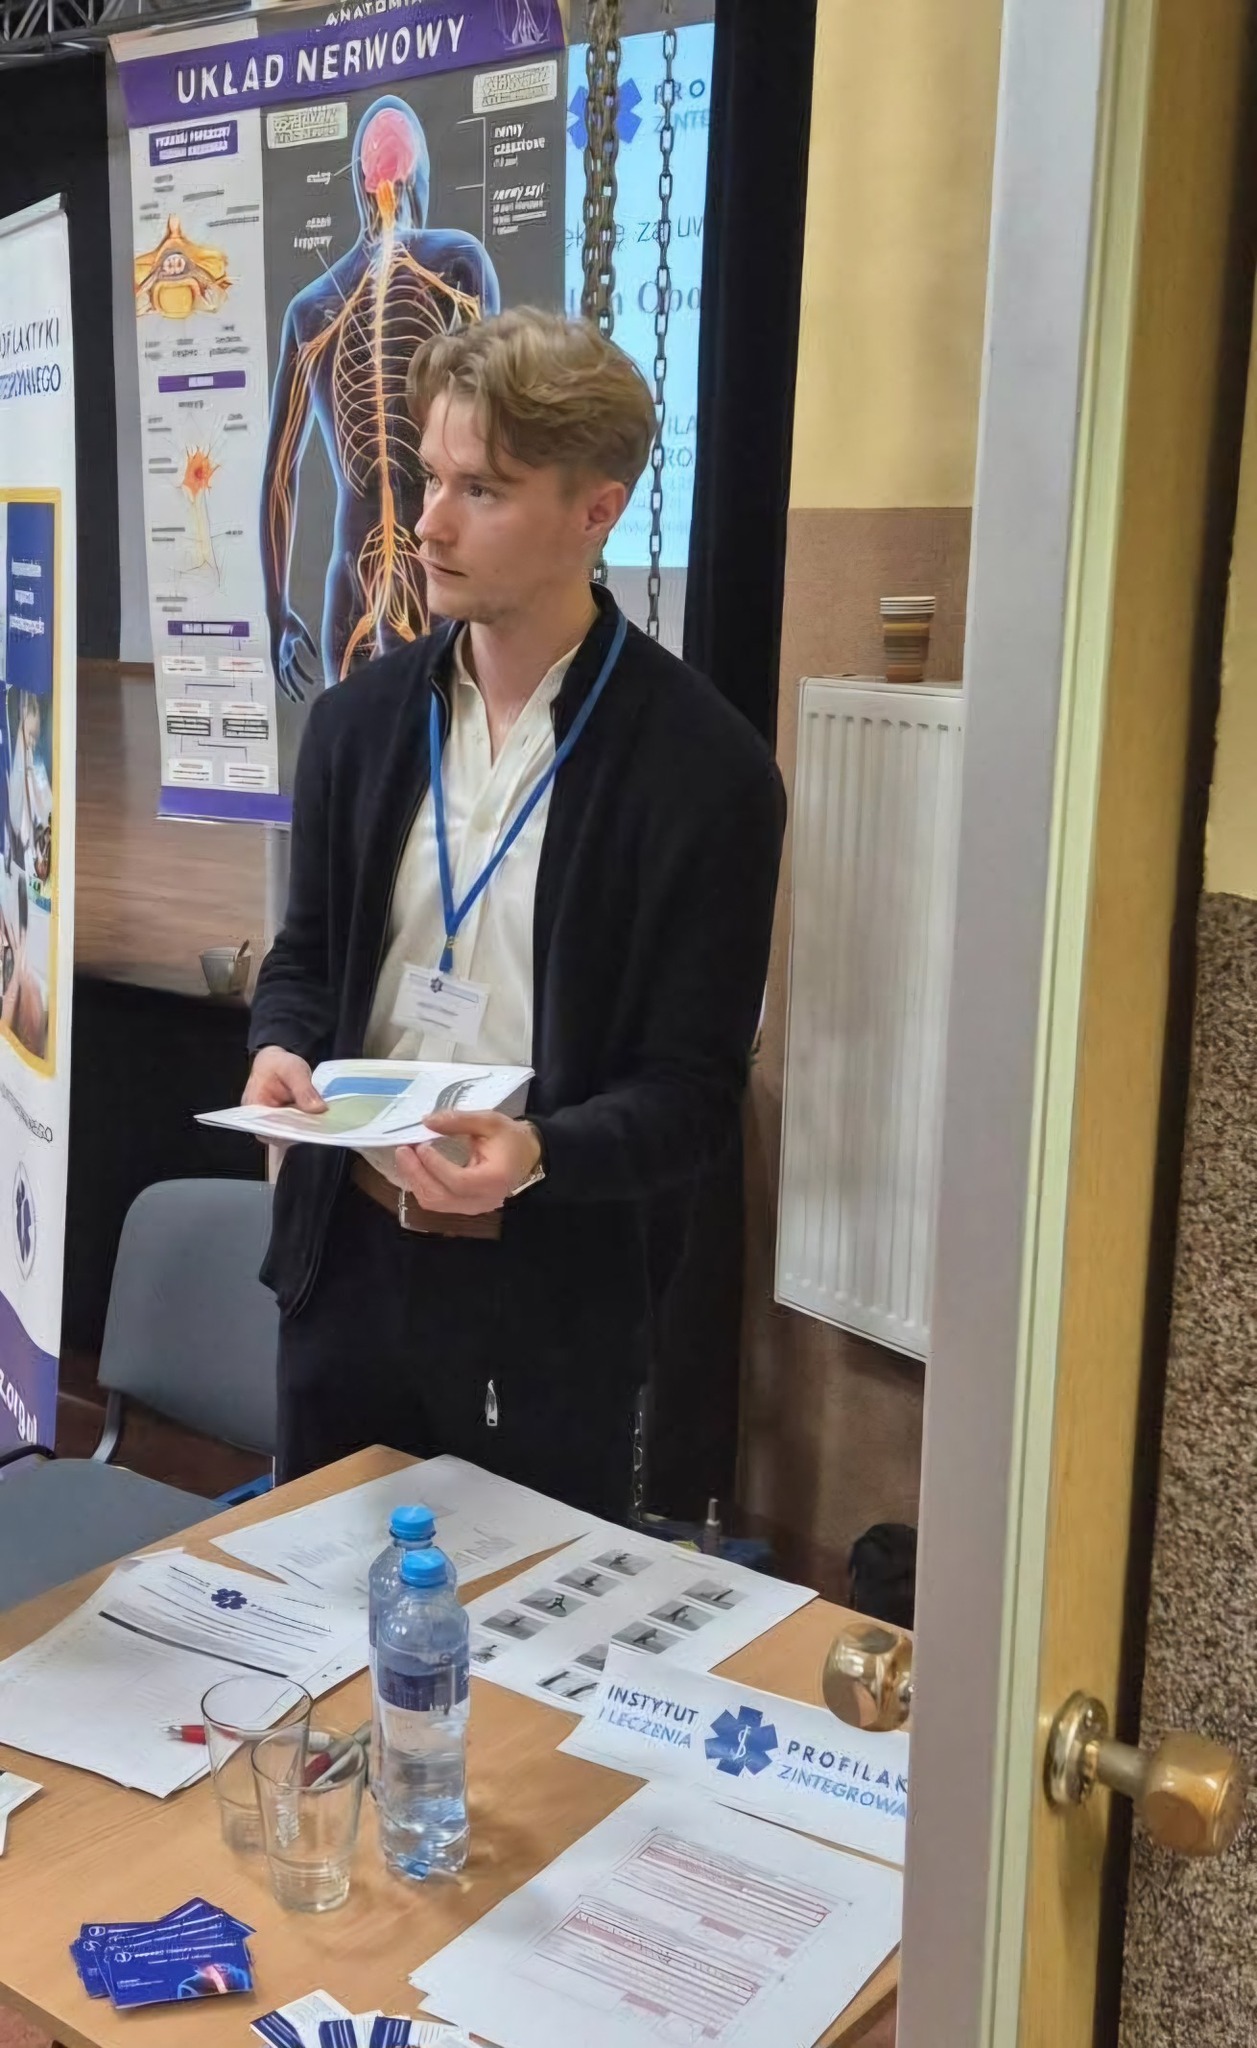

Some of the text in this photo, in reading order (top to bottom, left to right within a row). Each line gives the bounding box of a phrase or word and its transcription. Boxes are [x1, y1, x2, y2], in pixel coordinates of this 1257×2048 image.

[178, 15, 465, 103] UKŁAD NERWOWY
[607, 1684, 699, 1725] INSTYTUT
[608, 1710, 691, 1750] LECZENIA
